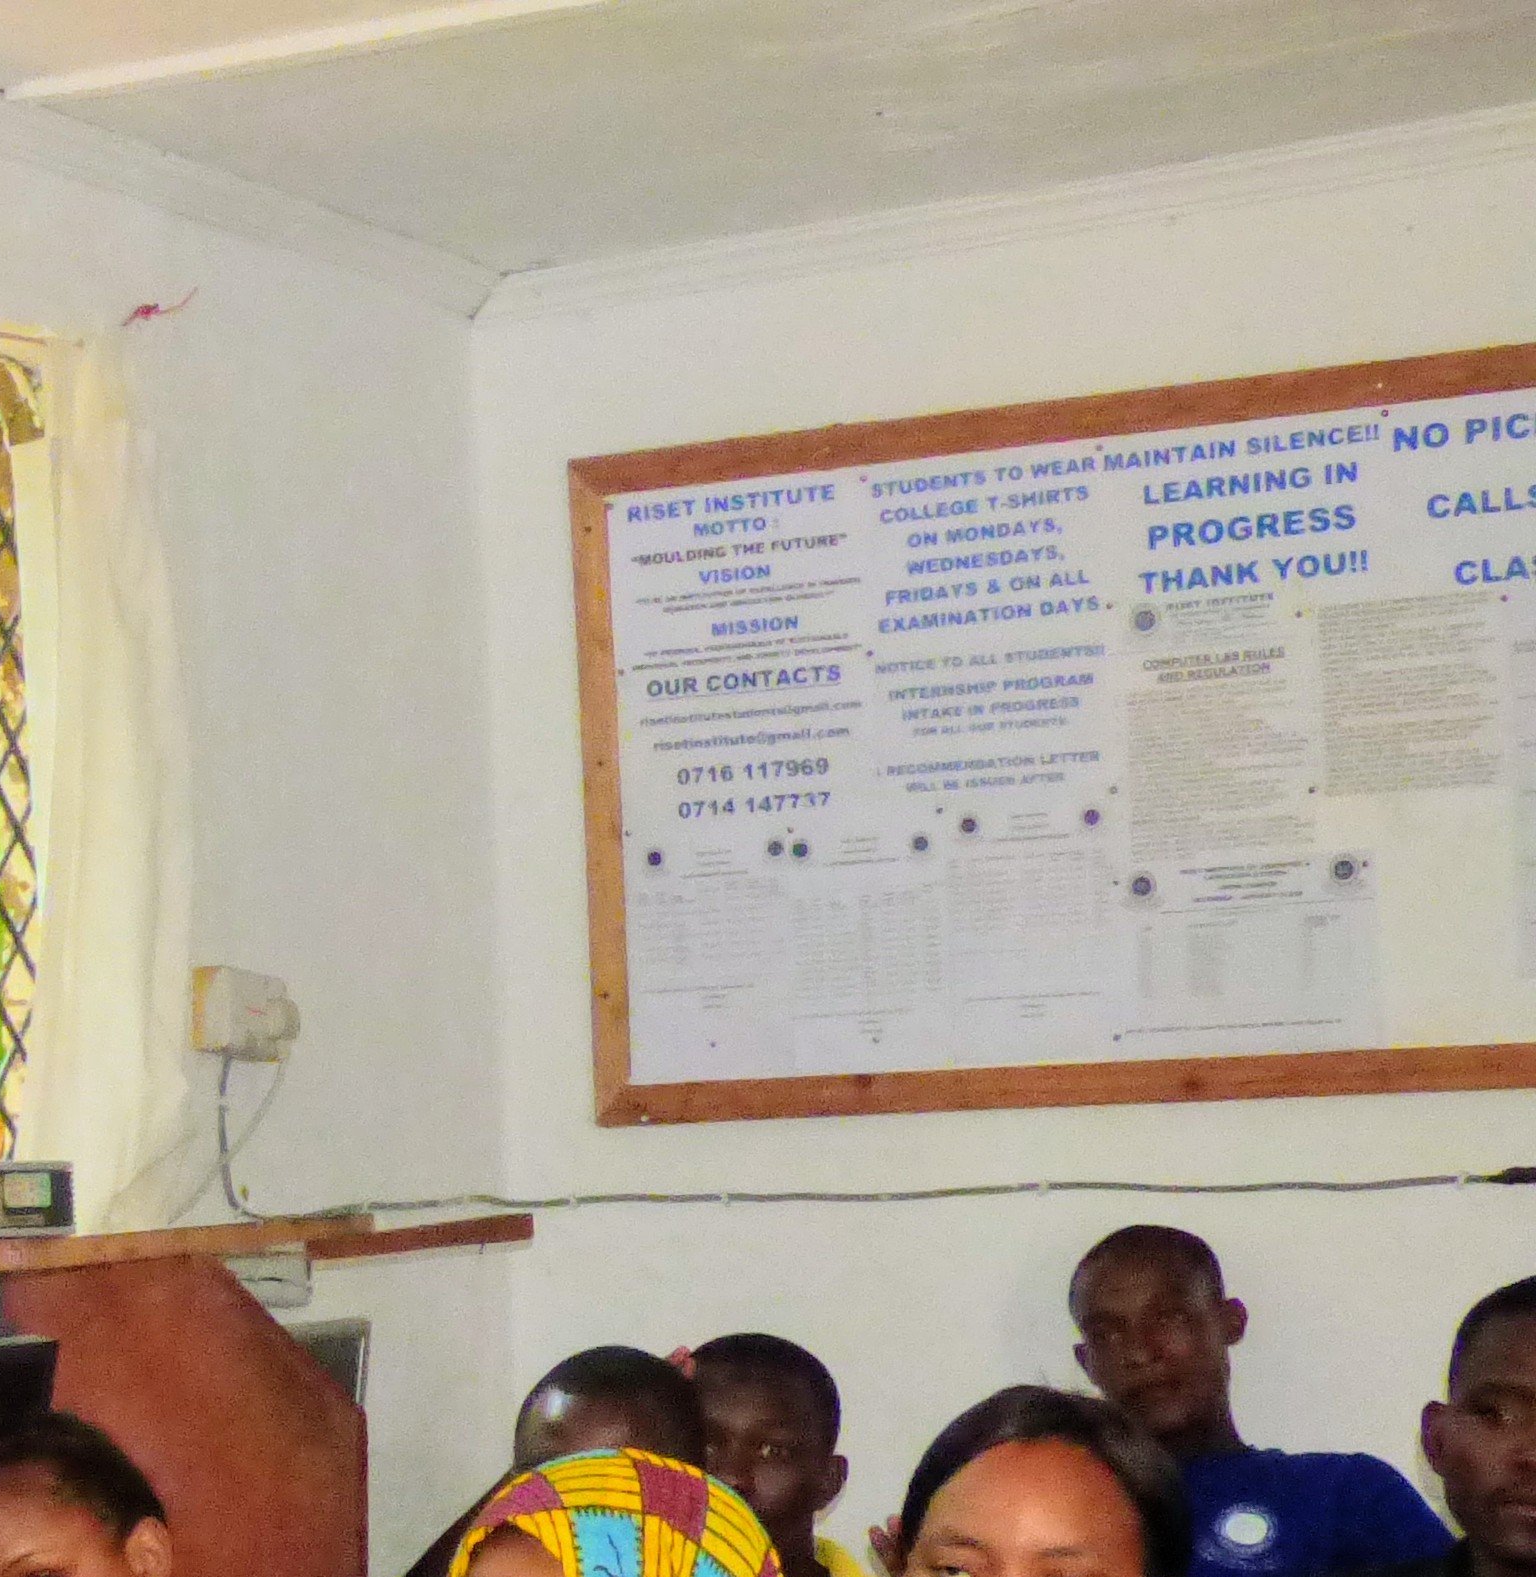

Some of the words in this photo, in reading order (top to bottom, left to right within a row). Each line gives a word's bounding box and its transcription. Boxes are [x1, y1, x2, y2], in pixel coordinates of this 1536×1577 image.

[1103, 440, 1236, 472] MAINTAIN
[1246, 423, 1380, 455] SILENCE!!
[1393, 422, 1449, 452] NO
[1465, 413, 1536, 445] PIC
[871, 470, 986, 499] STUDENTS
[994, 466, 1023, 482] TO
[1030, 456, 1096, 479] WEAR
[1143, 466, 1312, 505] LEARNING
[1324, 461, 1359, 485] IN
[627, 499, 696, 523] RISET
[704, 484, 835, 514] INSTITUTE
[879, 499, 979, 524] COLLEGE
[986, 485, 1090, 511] T-SHIRTS
[693, 517, 766, 537] MOTTO
[907, 532, 938, 548] ON
[946, 518, 1063, 544] MONDAYS,
[1148, 504, 1356, 550] PROGRESS
[732, 542, 764, 556] THE
[907, 545, 1065, 575] WEDNESDAYS,
[699, 564, 771, 585] VISION
[885, 582, 978, 607] FRIDAYS
[987, 579, 1001, 594] &
[1009, 575, 1041, 592] ON
[1049, 569, 1090, 588] ALL
[1138, 560, 1260, 595] THANK
[1272, 550, 1369, 581] YOU!!
[1454, 556, 1536, 585] CLA
[711, 616, 799, 637] MISSION
[878, 603, 1032, 634] EXAMINATION
[1039, 595, 1100, 616] DAYS
[647, 676, 698, 697] OUR
[706, 664, 842, 693] CONTACTS
[678, 765, 734, 786] 0716
[743, 757, 829, 781] 117969
[678, 797, 735, 819] 0714
